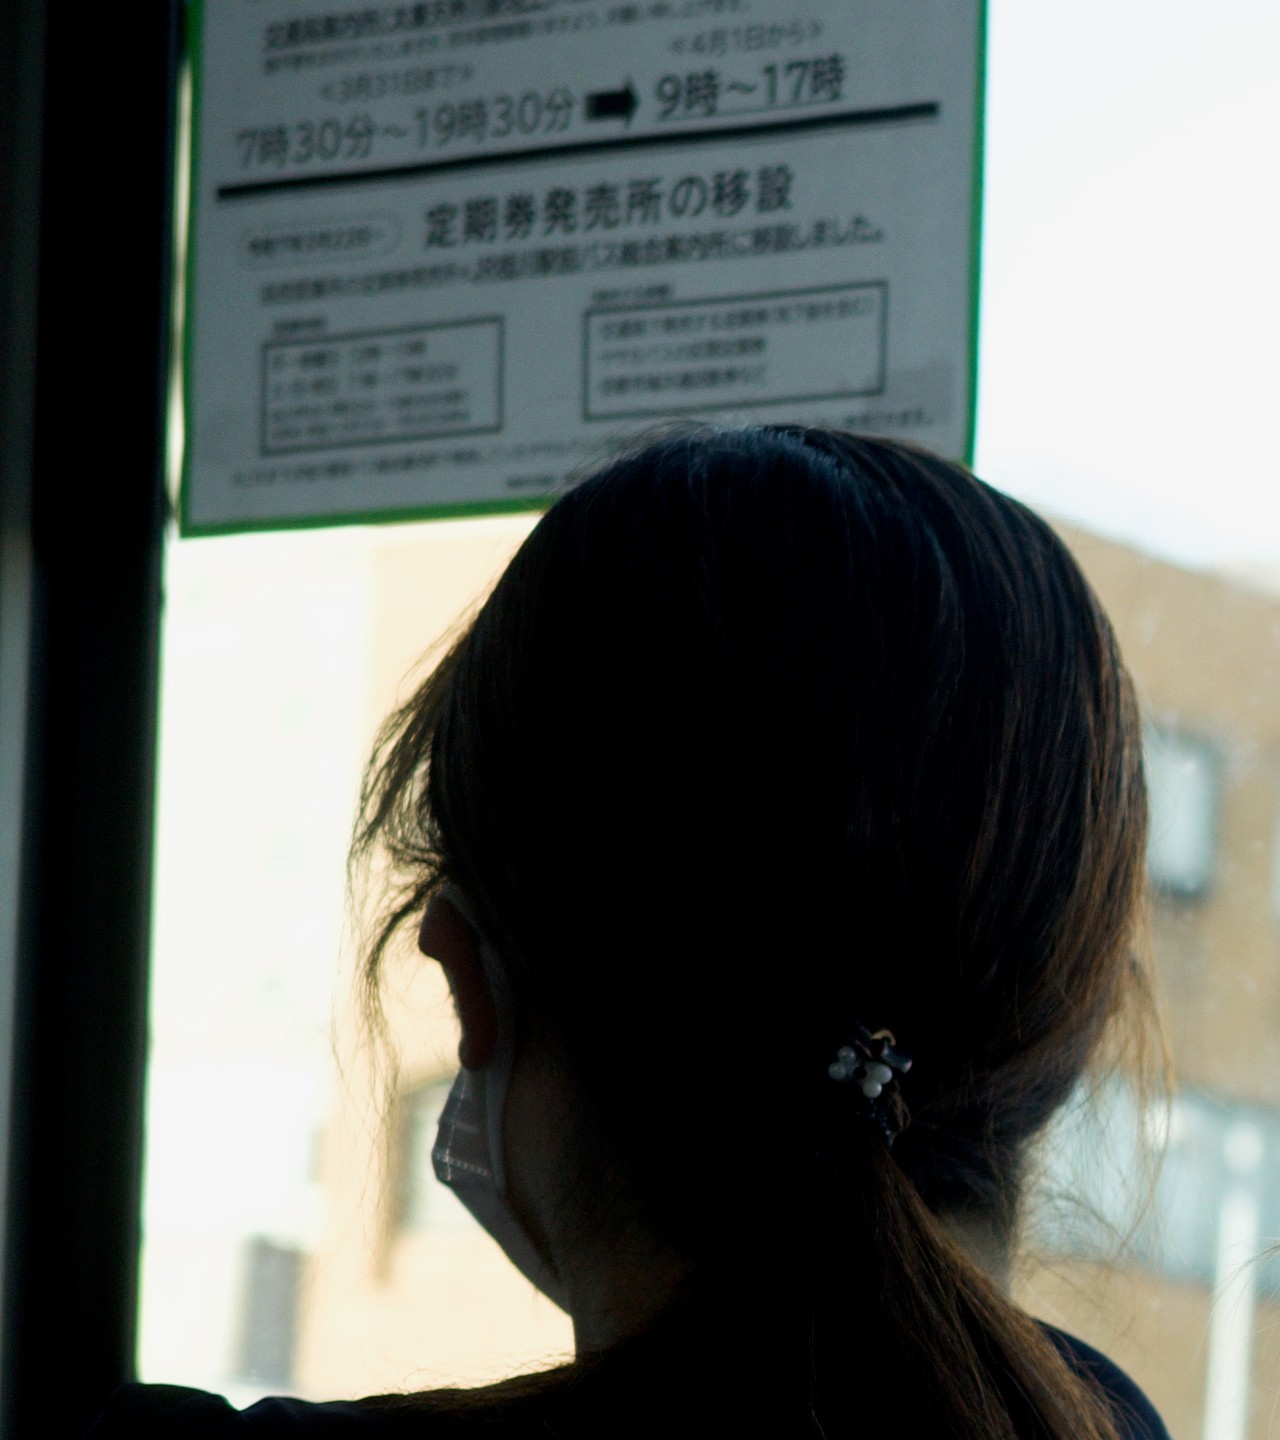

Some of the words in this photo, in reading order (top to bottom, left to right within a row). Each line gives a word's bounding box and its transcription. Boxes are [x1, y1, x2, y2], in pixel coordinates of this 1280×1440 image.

[423, 164, 797, 251] 定期券発売所の移設
